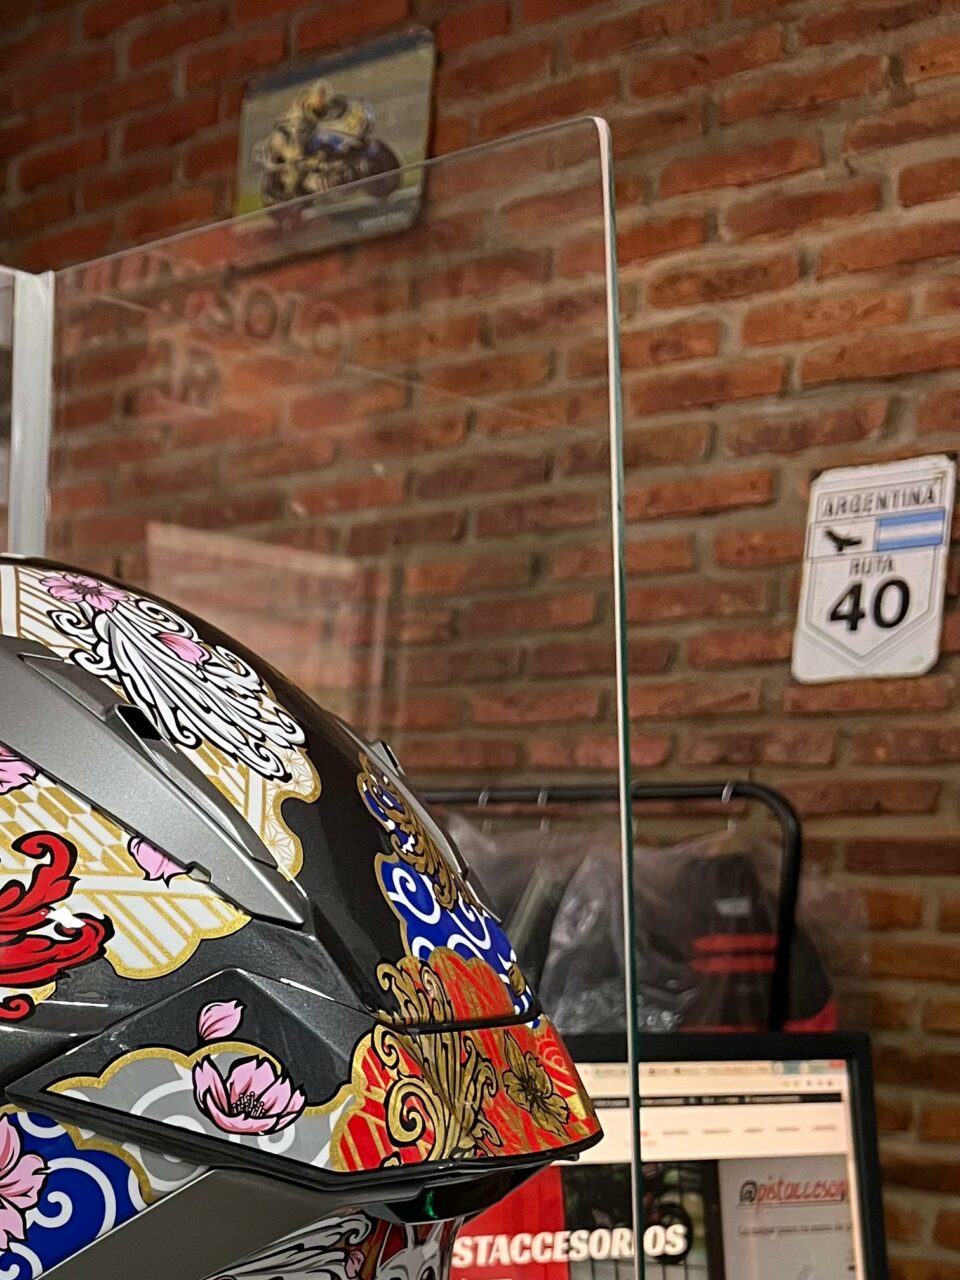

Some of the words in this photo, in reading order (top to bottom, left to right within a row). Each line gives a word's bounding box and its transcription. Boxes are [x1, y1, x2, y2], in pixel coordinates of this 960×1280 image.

[822, 485, 936, 518] ARGENTINA
[849, 556, 895, 577] RUTA
[828, 577, 911, 632] 40
[452, 1224, 688, 1268] STACCESOROS
